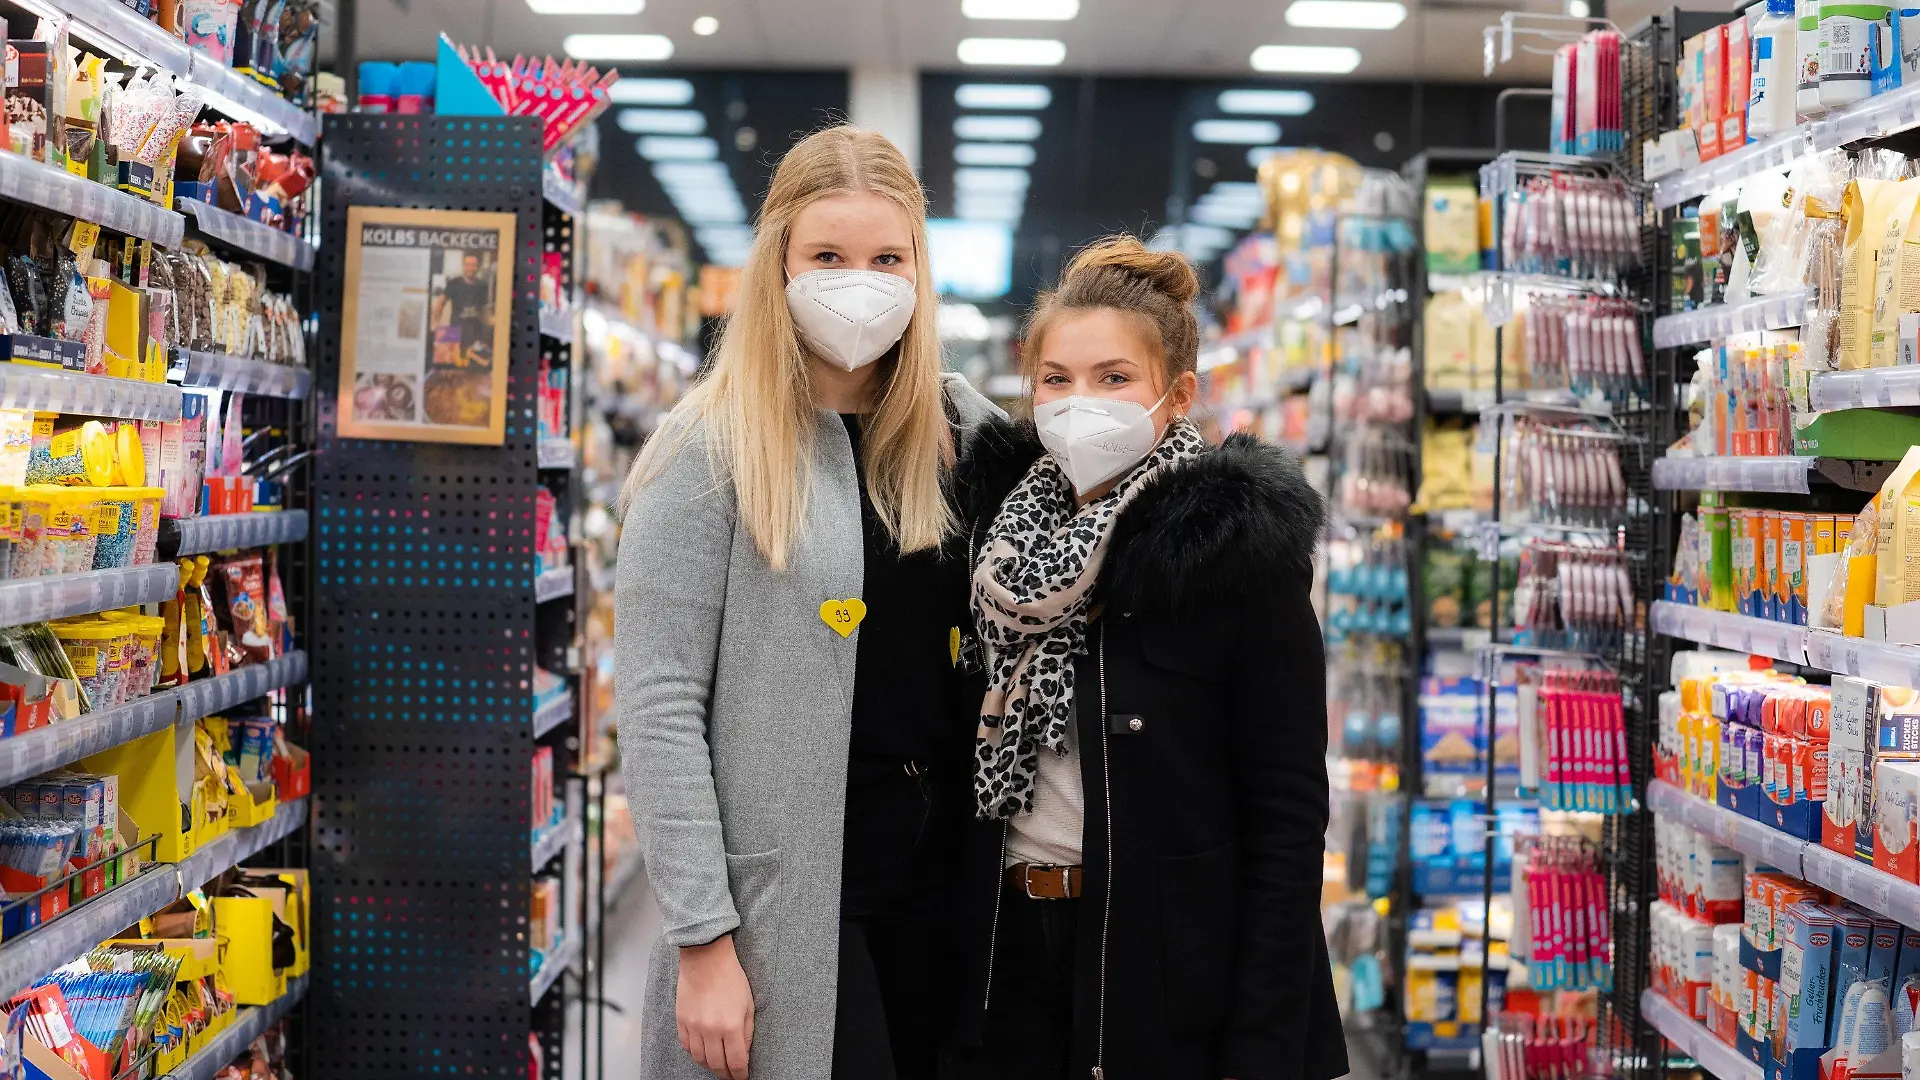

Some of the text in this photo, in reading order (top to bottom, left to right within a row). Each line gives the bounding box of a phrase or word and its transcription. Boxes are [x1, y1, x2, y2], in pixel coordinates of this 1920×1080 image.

[363, 228, 498, 249] KOLBS BACKECKE
[1903, 717, 1911, 750] ZUCKER
[1911, 718, 1919, 749] STICKS
[1805, 977, 1815, 1006] Gelier-
[1813, 964, 1828, 1025] Fruchtzucker
